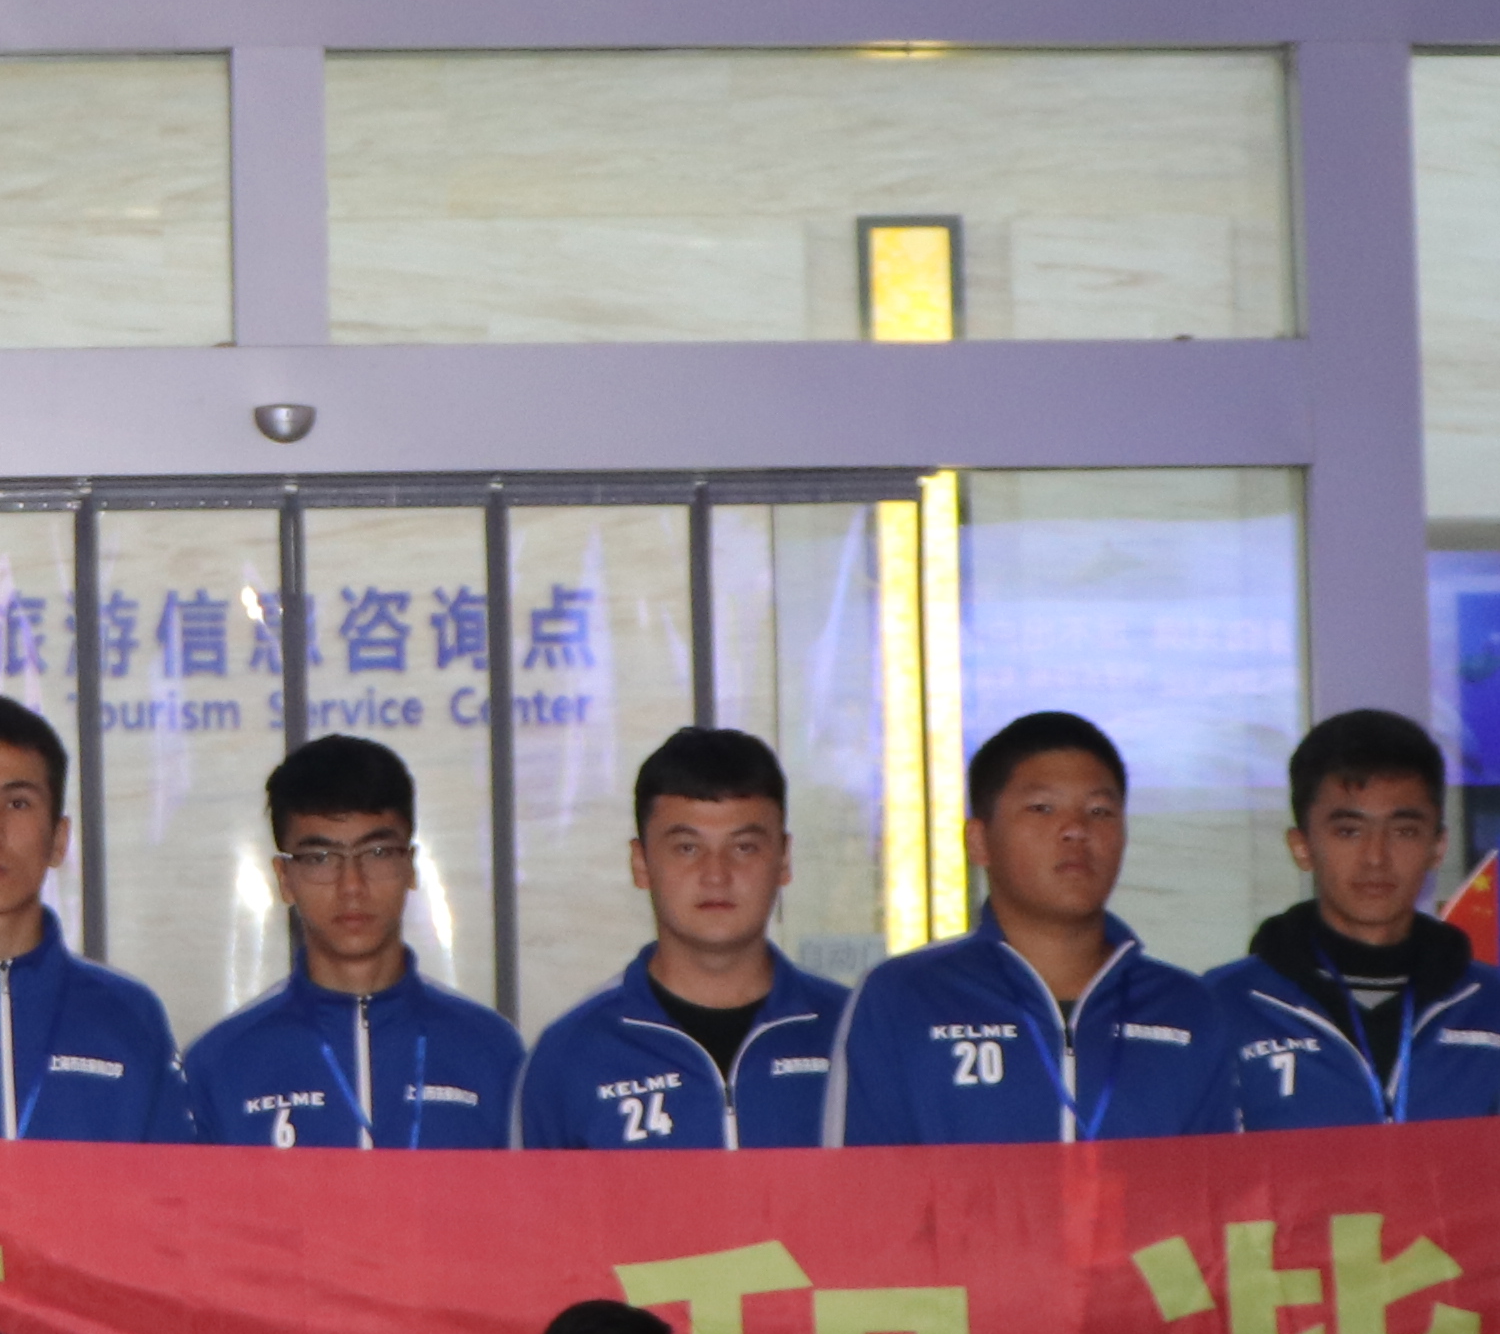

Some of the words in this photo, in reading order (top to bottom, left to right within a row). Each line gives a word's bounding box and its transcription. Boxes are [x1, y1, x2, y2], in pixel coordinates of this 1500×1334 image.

[66, 689, 240, 734] ourism
[930, 1024, 1018, 1040] KELME
[953, 1040, 1004, 1086] 20
[1269, 1051, 1295, 1097] 7
[244, 1091, 326, 1113] KELME
[598, 1072, 683, 1100] KELME
[272, 1107, 297, 1149] 6
[618, 1091, 673, 1143] 24
